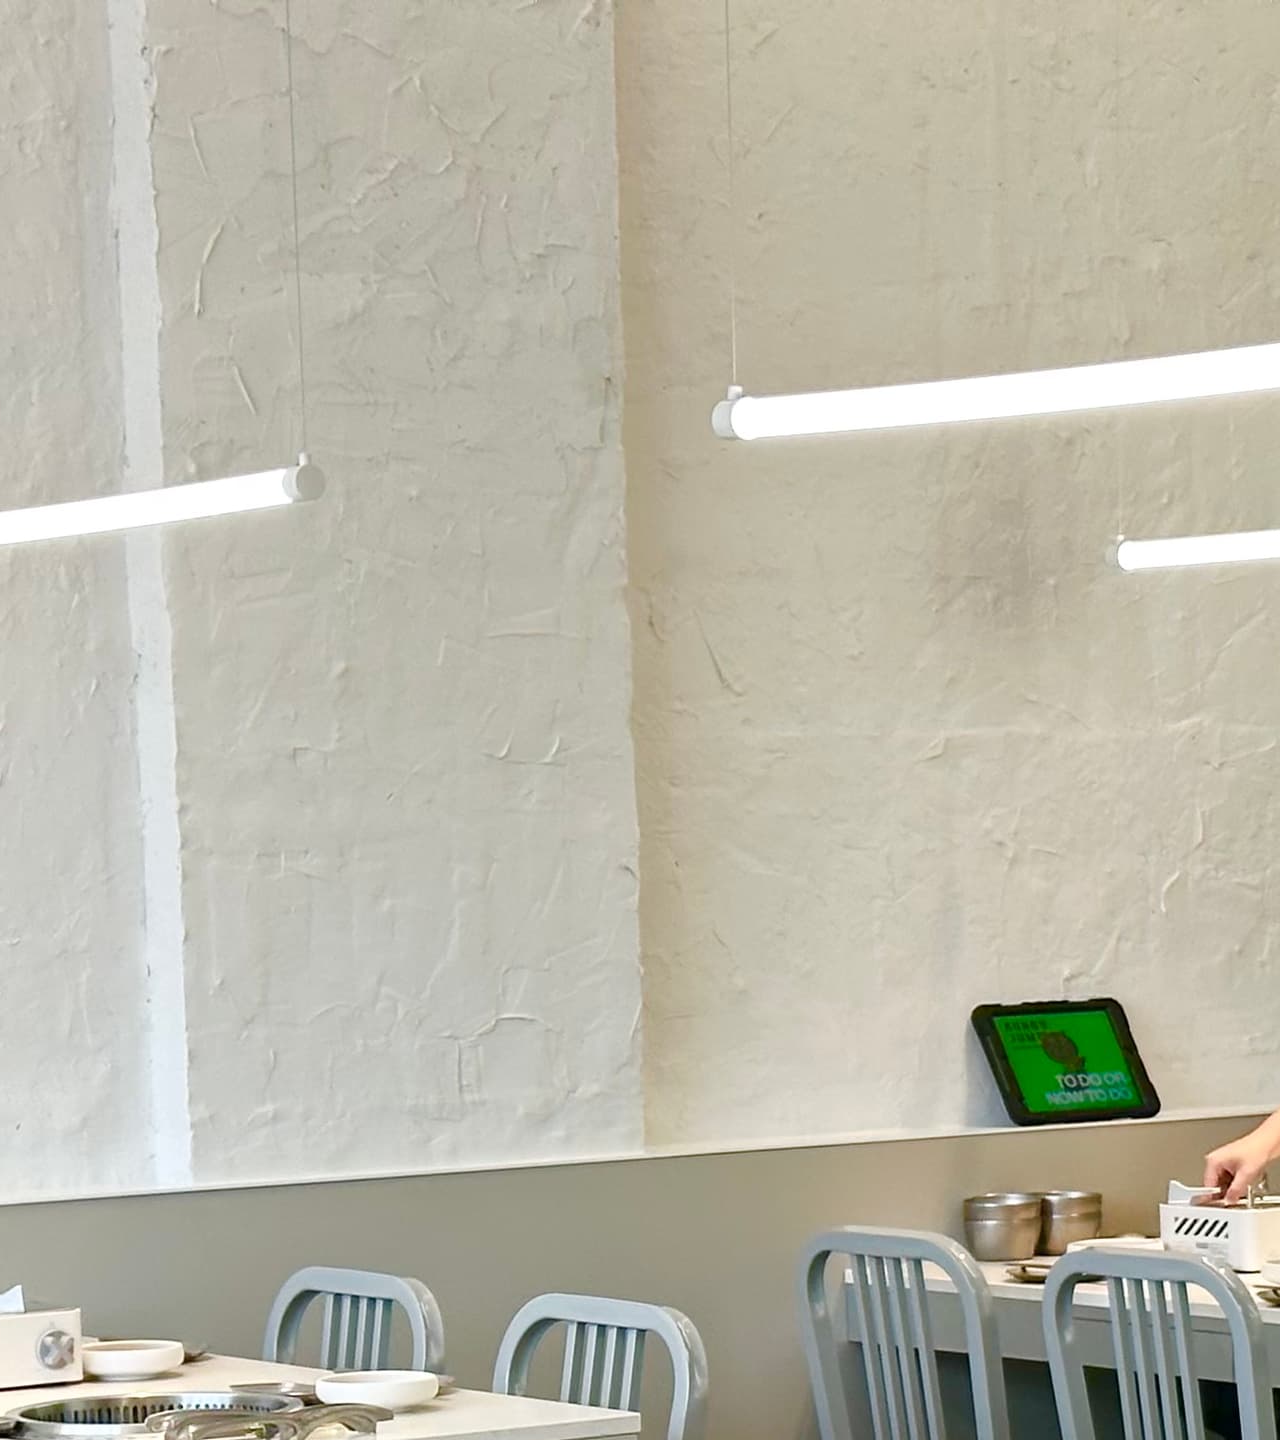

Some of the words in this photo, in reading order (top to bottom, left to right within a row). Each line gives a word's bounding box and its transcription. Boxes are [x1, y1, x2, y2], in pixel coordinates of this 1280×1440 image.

[1055, 1074, 1077, 1089] TO
[1077, 1073, 1102, 1088] DO
[1103, 1071, 1127, 1086] OR
[1045, 1089, 1084, 1105] NOW
[1084, 1088, 1107, 1103] TO
[1108, 1086, 1133, 1100] DO
